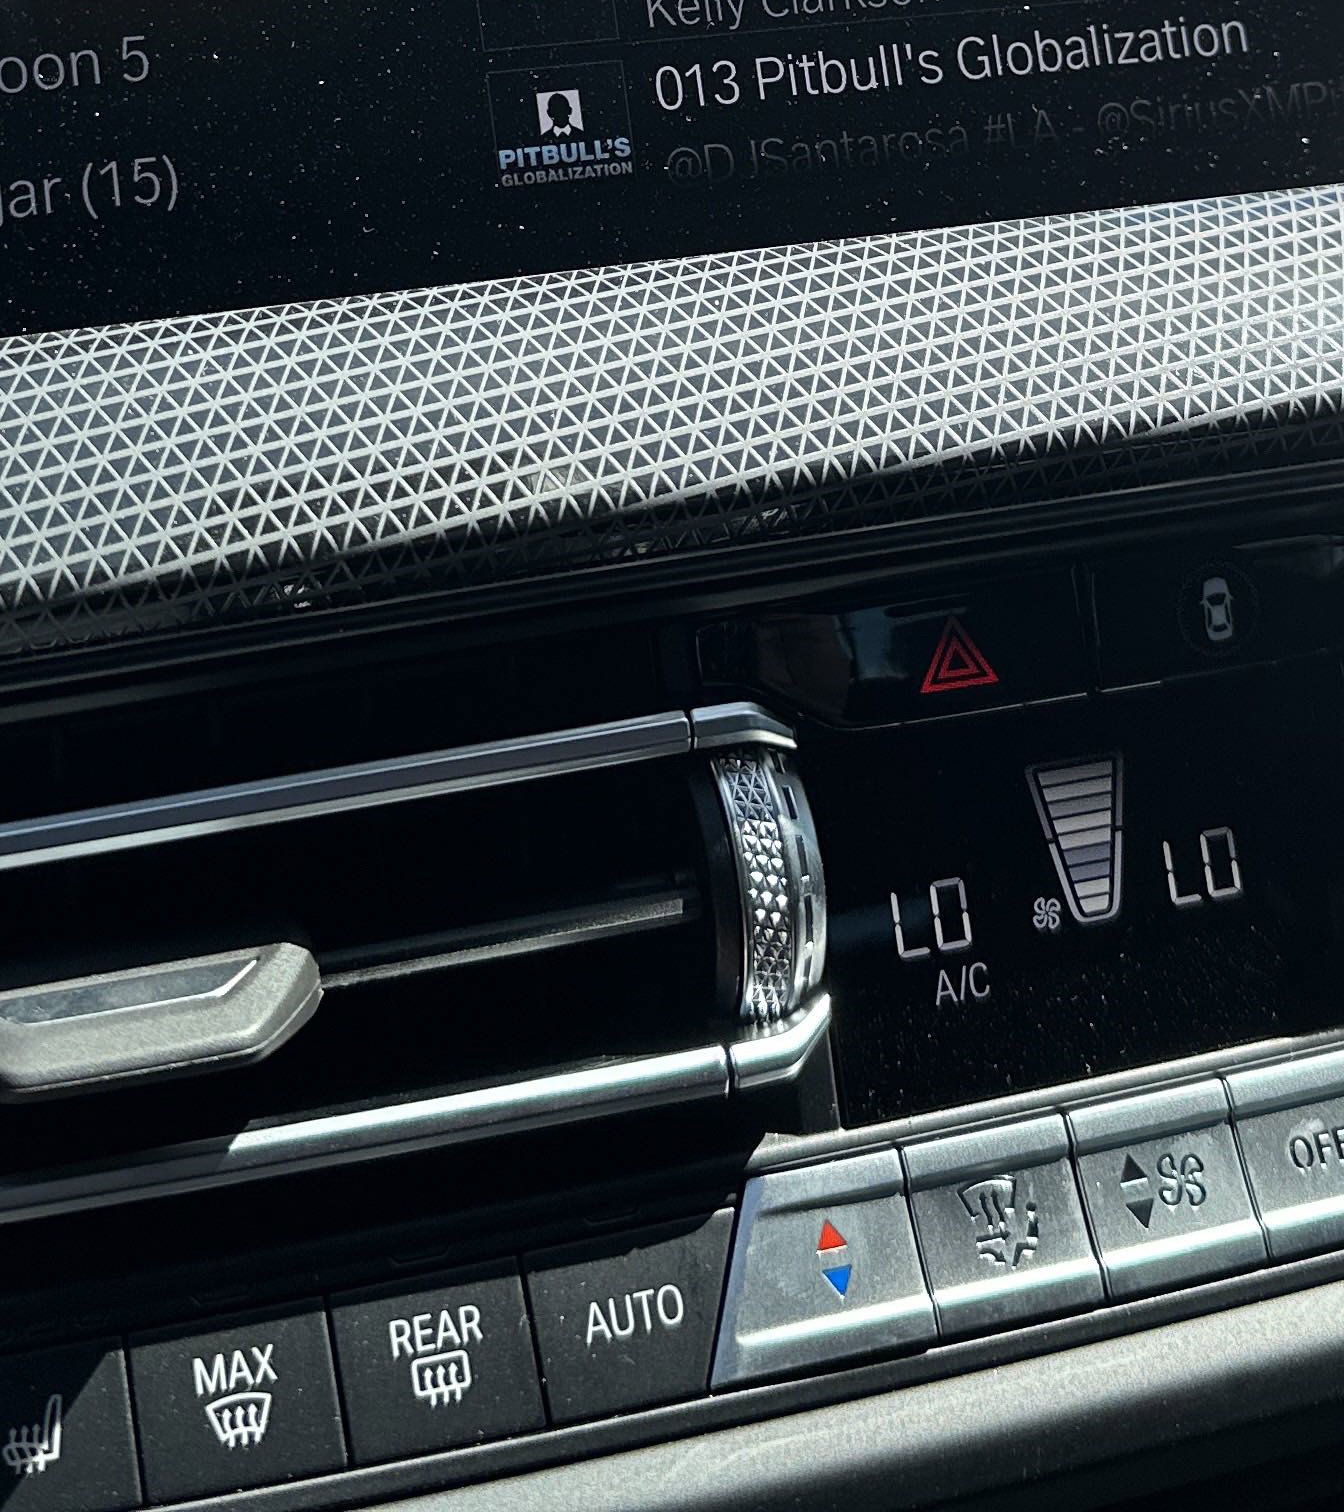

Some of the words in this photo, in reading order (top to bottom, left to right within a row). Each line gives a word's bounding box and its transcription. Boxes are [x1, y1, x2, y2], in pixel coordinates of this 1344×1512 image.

[120, 35, 151, 83] 5
[655, 62, 741, 112] 013
[755, 41, 944, 101] Pitbull's
[958, 15, 1249, 80] Globalization
[499, 138, 632, 170] PITBULL'S
[501, 161, 633, 187] GLOBALIZATION
[82, 154, 180, 219] (15)
[936, 962, 991, 1006] A/C
[388, 1304, 484, 1359] REAR
[585, 1283, 685, 1345] AUTO
[193, 1343, 278, 1397] MAX
